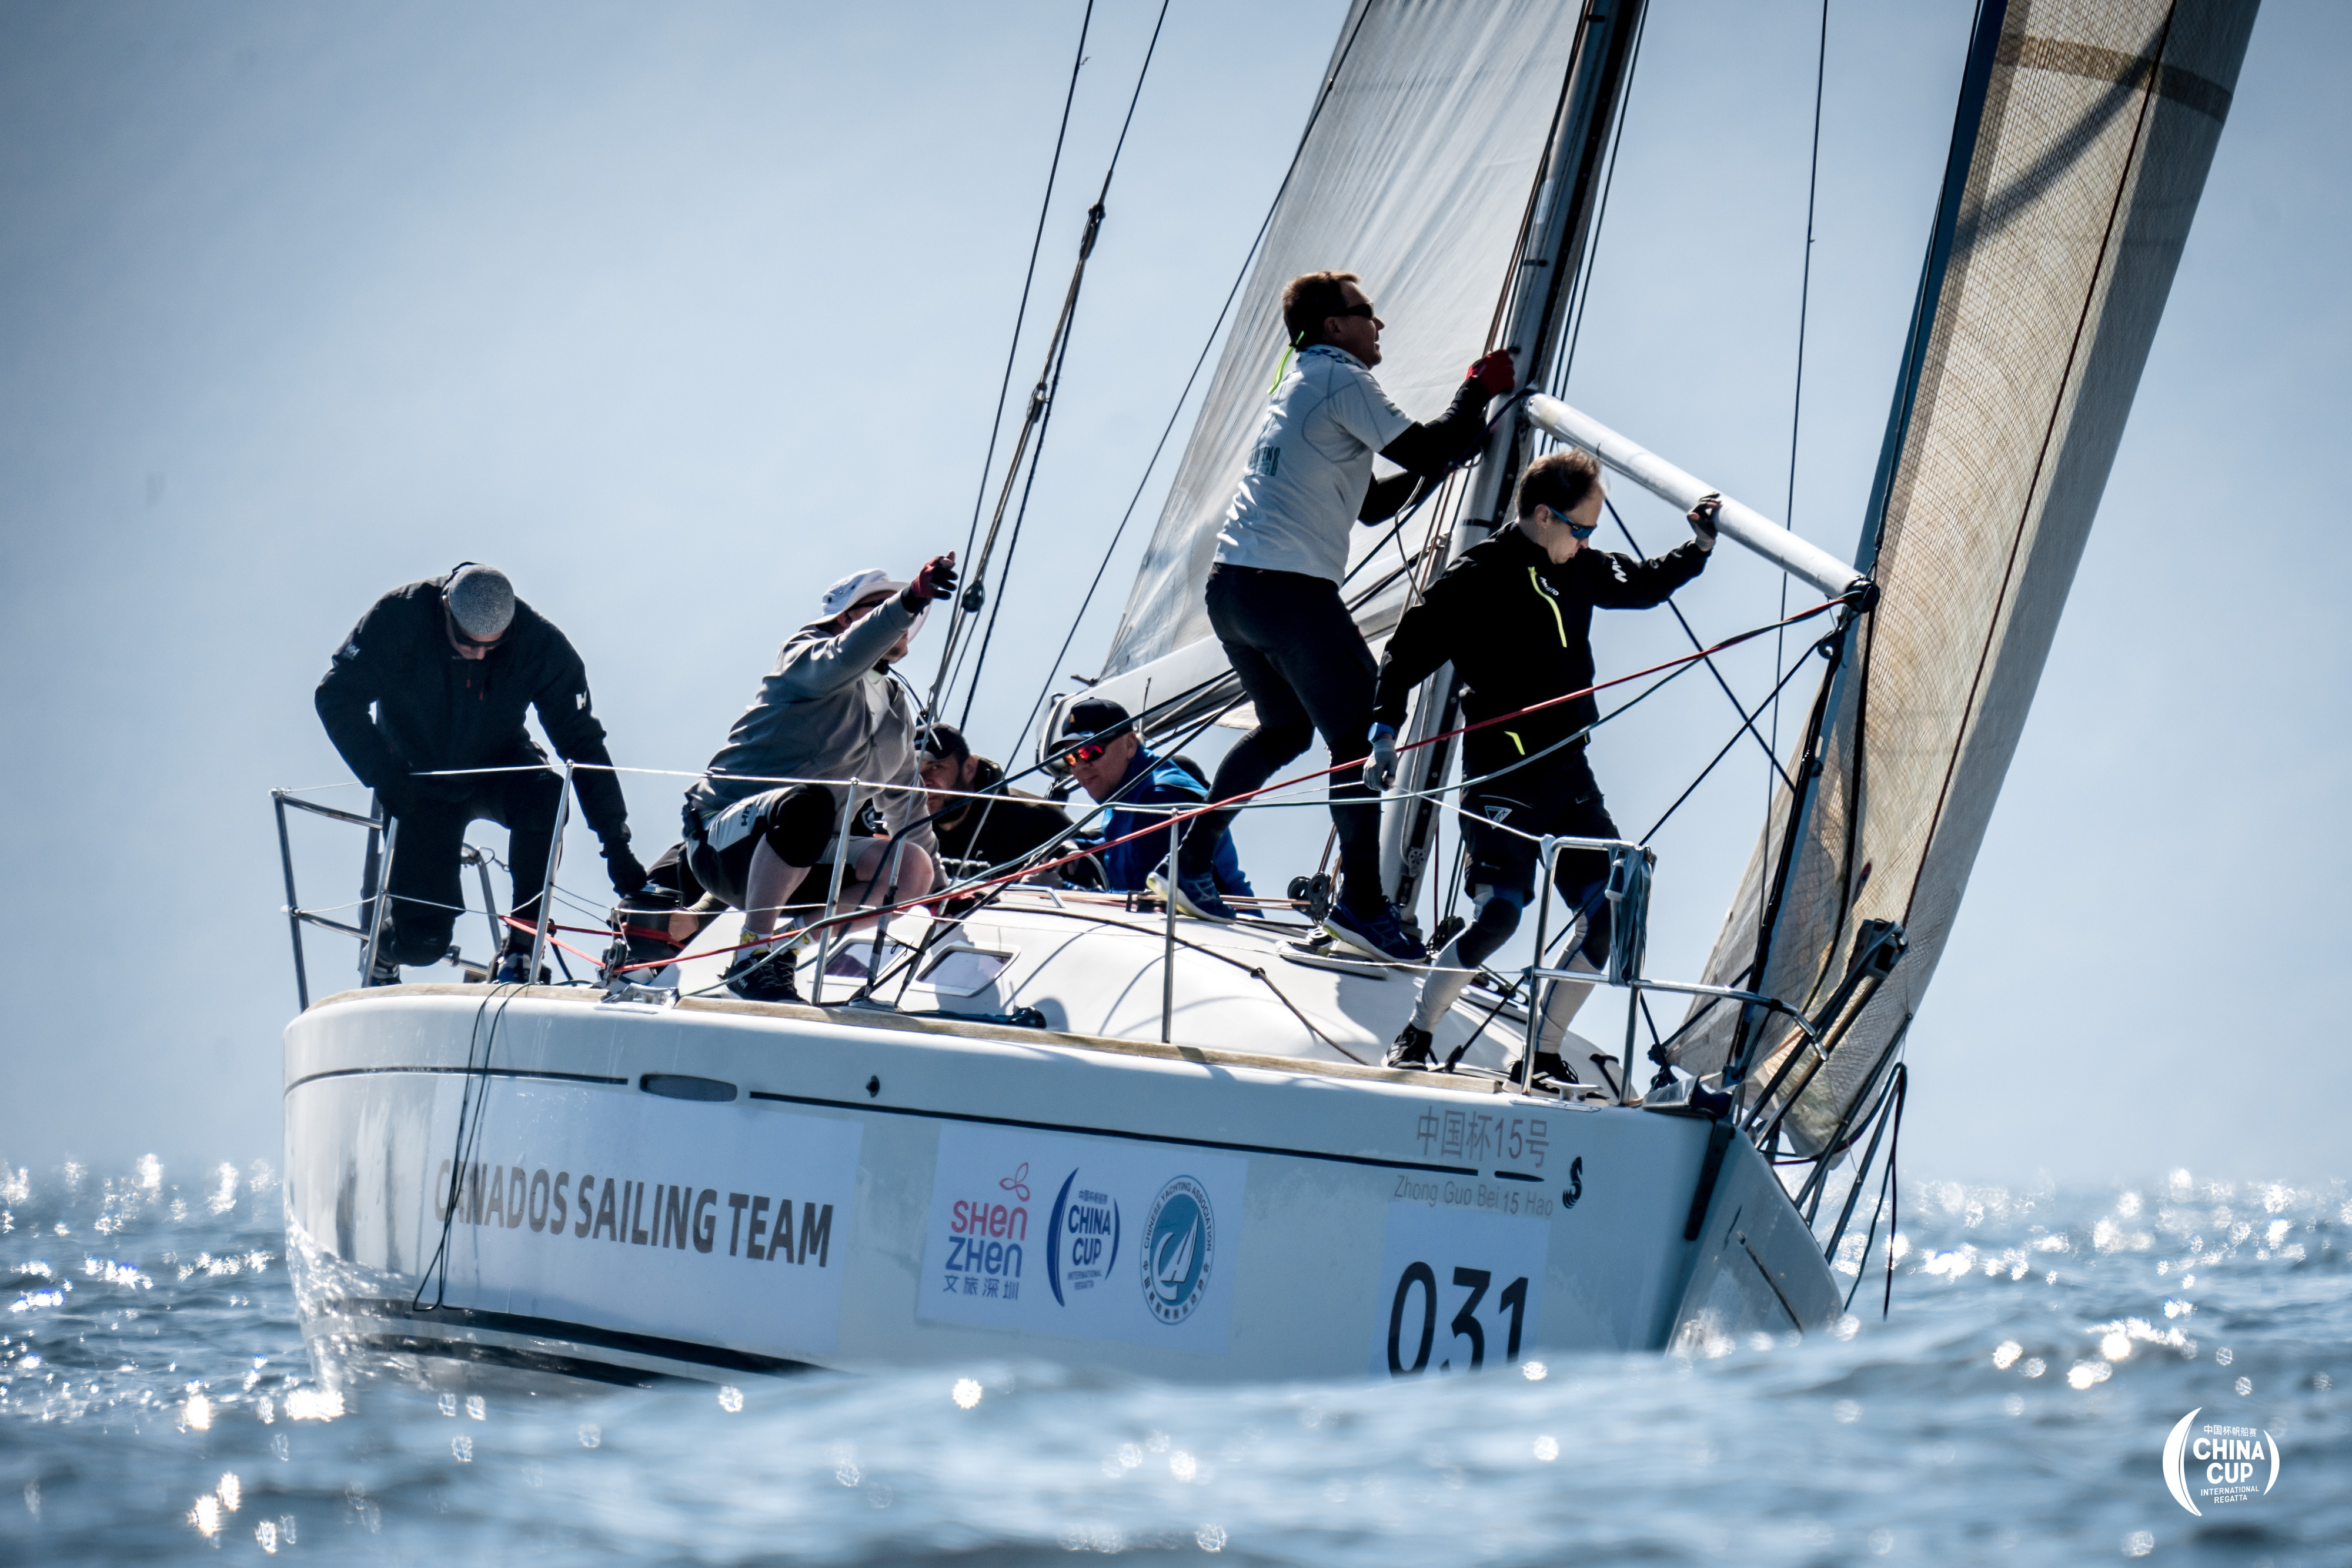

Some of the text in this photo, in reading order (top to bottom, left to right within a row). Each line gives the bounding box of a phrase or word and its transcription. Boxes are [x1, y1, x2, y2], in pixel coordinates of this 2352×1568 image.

[1416, 1106, 1550, 1168] 中国杯15号
[574, 1175, 717, 1254] SAILING
[729, 1192, 834, 1268] TEAM
[1068, 1204, 1111, 1235] CHINA
[1191, 1186, 1212, 1252] ASSOCIATION
[1394, 1174, 1553, 1217] Zhong Guo Bei 15 Hao
[1073, 1237, 1102, 1266] CUP
[943, 1274, 1020, 1300] 文旅深圳
[1387, 1261, 1528, 1380] 031
